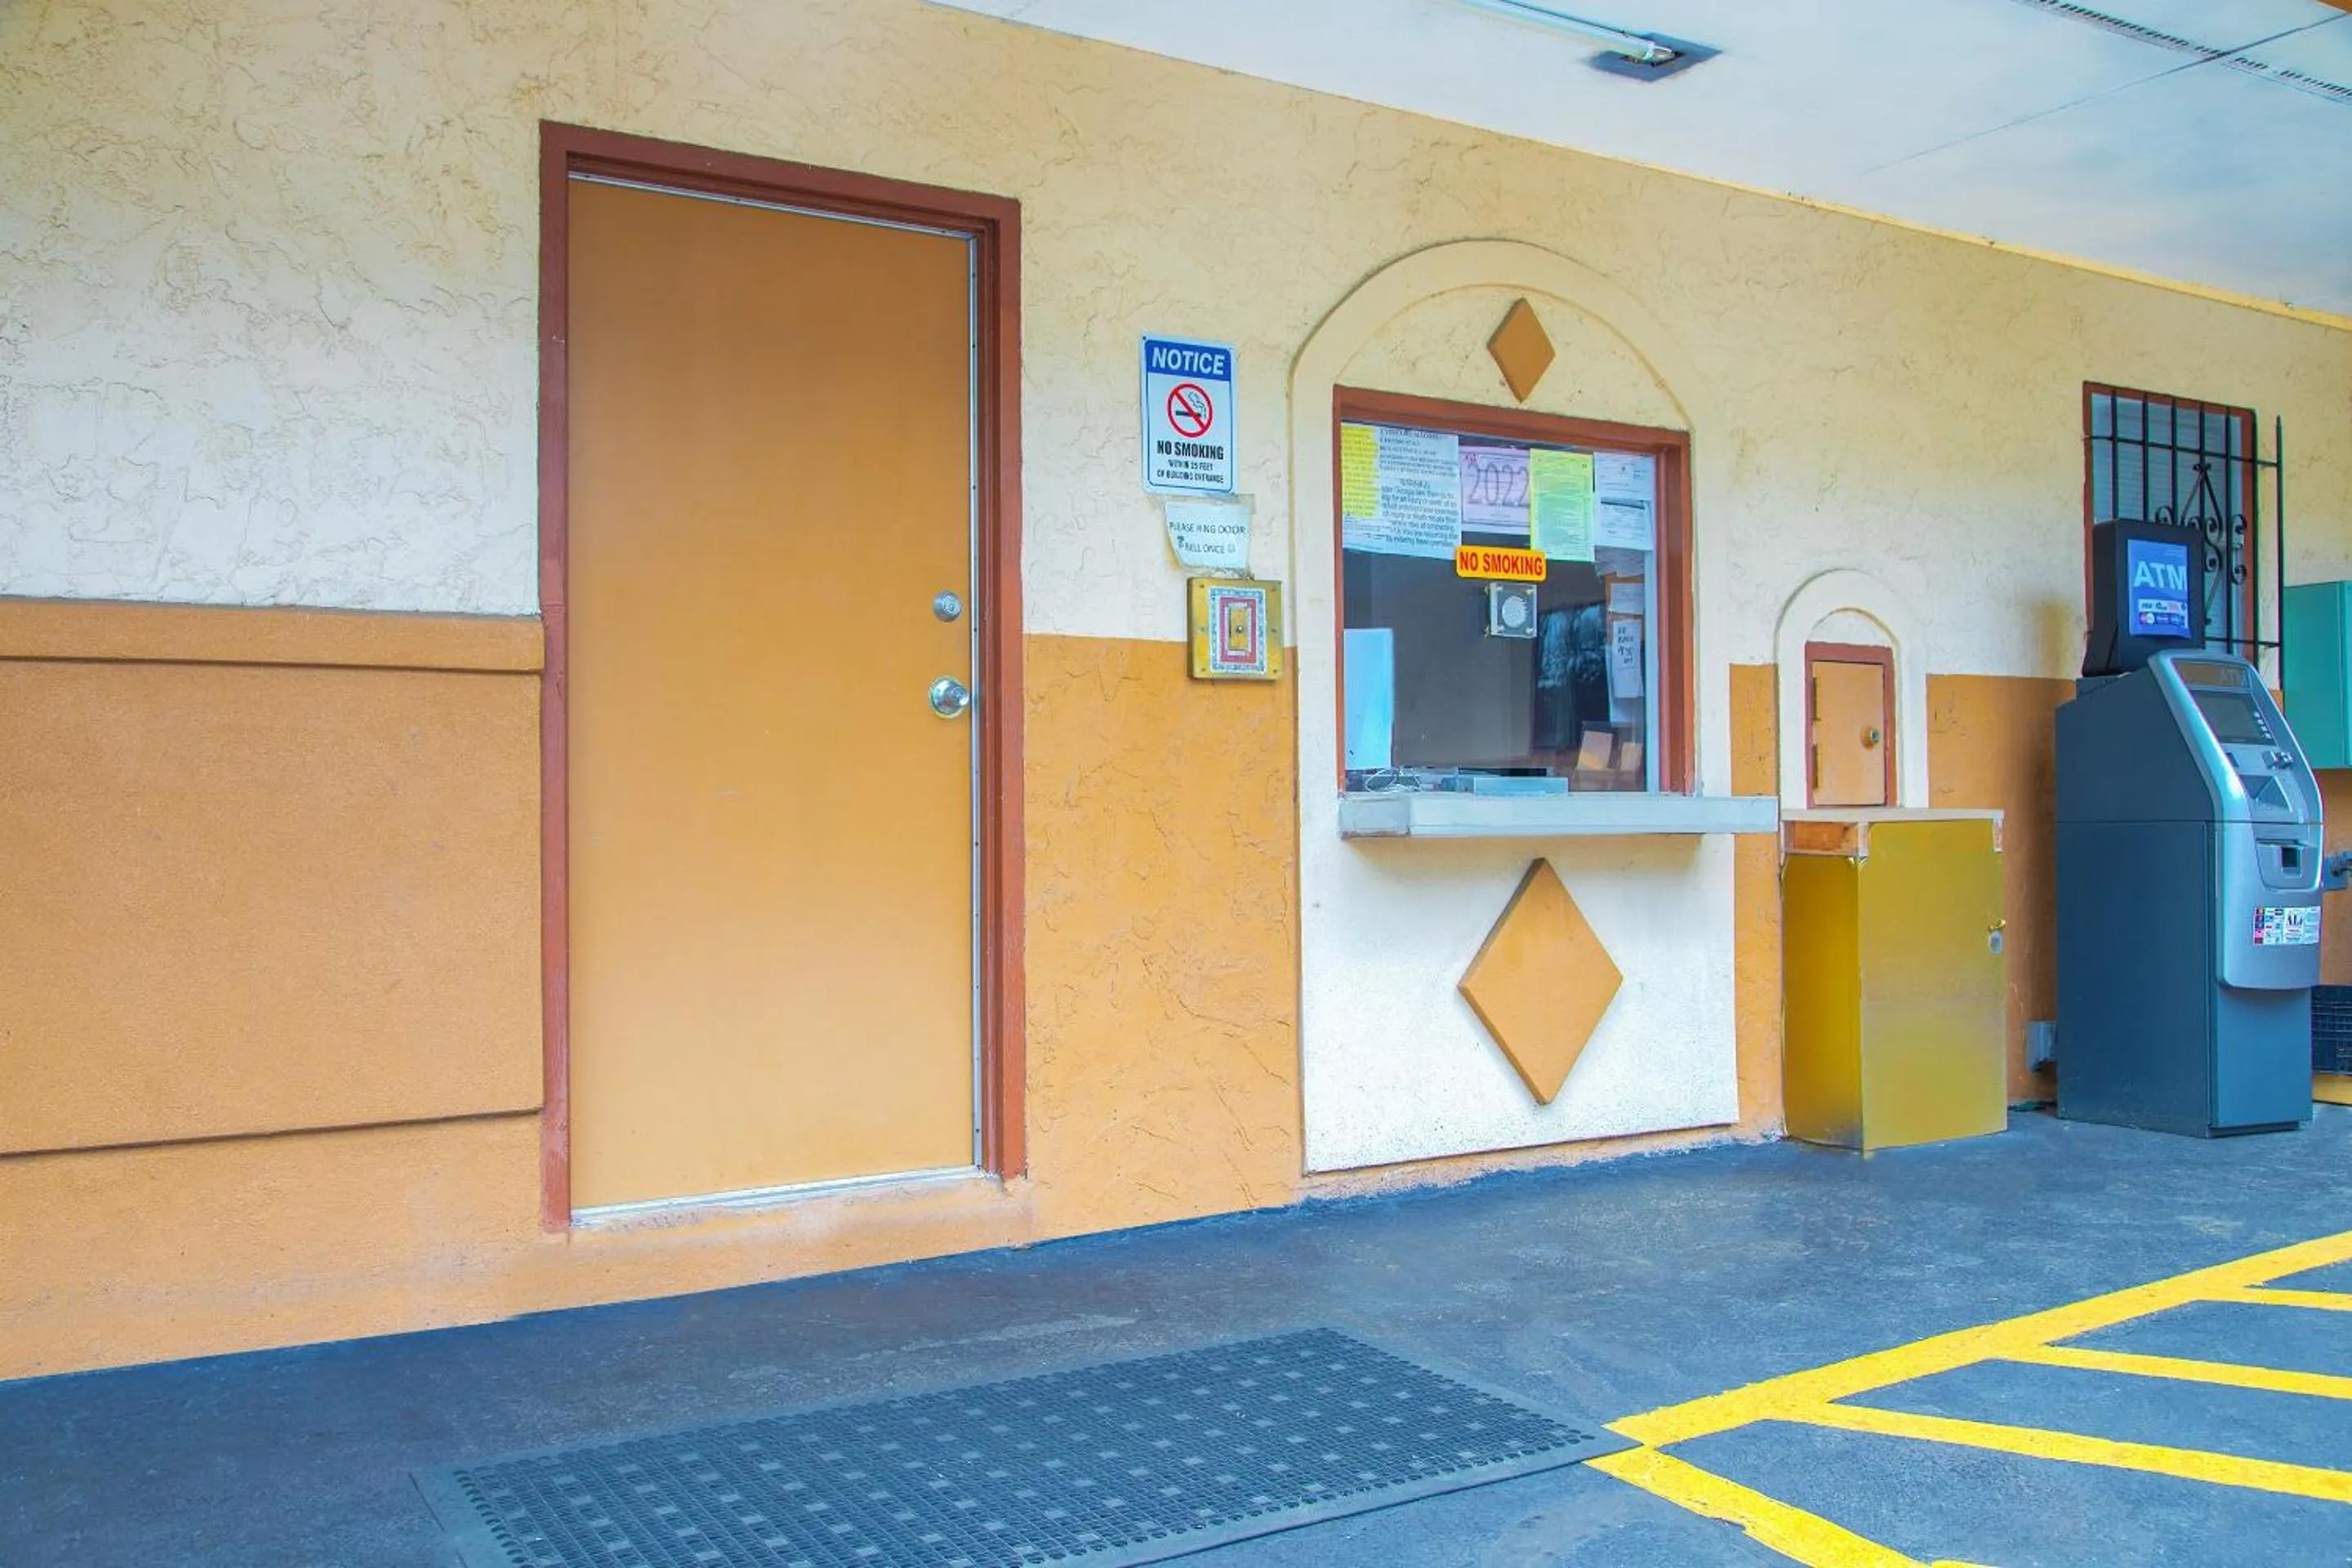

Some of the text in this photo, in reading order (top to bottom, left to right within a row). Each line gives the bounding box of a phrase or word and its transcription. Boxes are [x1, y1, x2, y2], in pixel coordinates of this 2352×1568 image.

[1152, 347, 1225, 375] NOTICE
[1156, 440, 1224, 460] NO SMOKING
[1168, 459, 1189, 469] WITHIN
[1199, 461, 1214, 471] FEET
[1166, 470, 1193, 480] BUILDING
[1194, 473, 1224, 483] ENTRANCE
[1468, 463, 1530, 507] 2022
[1169, 522, 1194, 532] PLEASE
[1218, 525, 1246, 535] DOOR
[1203, 543, 1225, 554] ONCE
[1459, 551, 1543, 576] NO SMOKING
[2133, 561, 2187, 590] ATM
